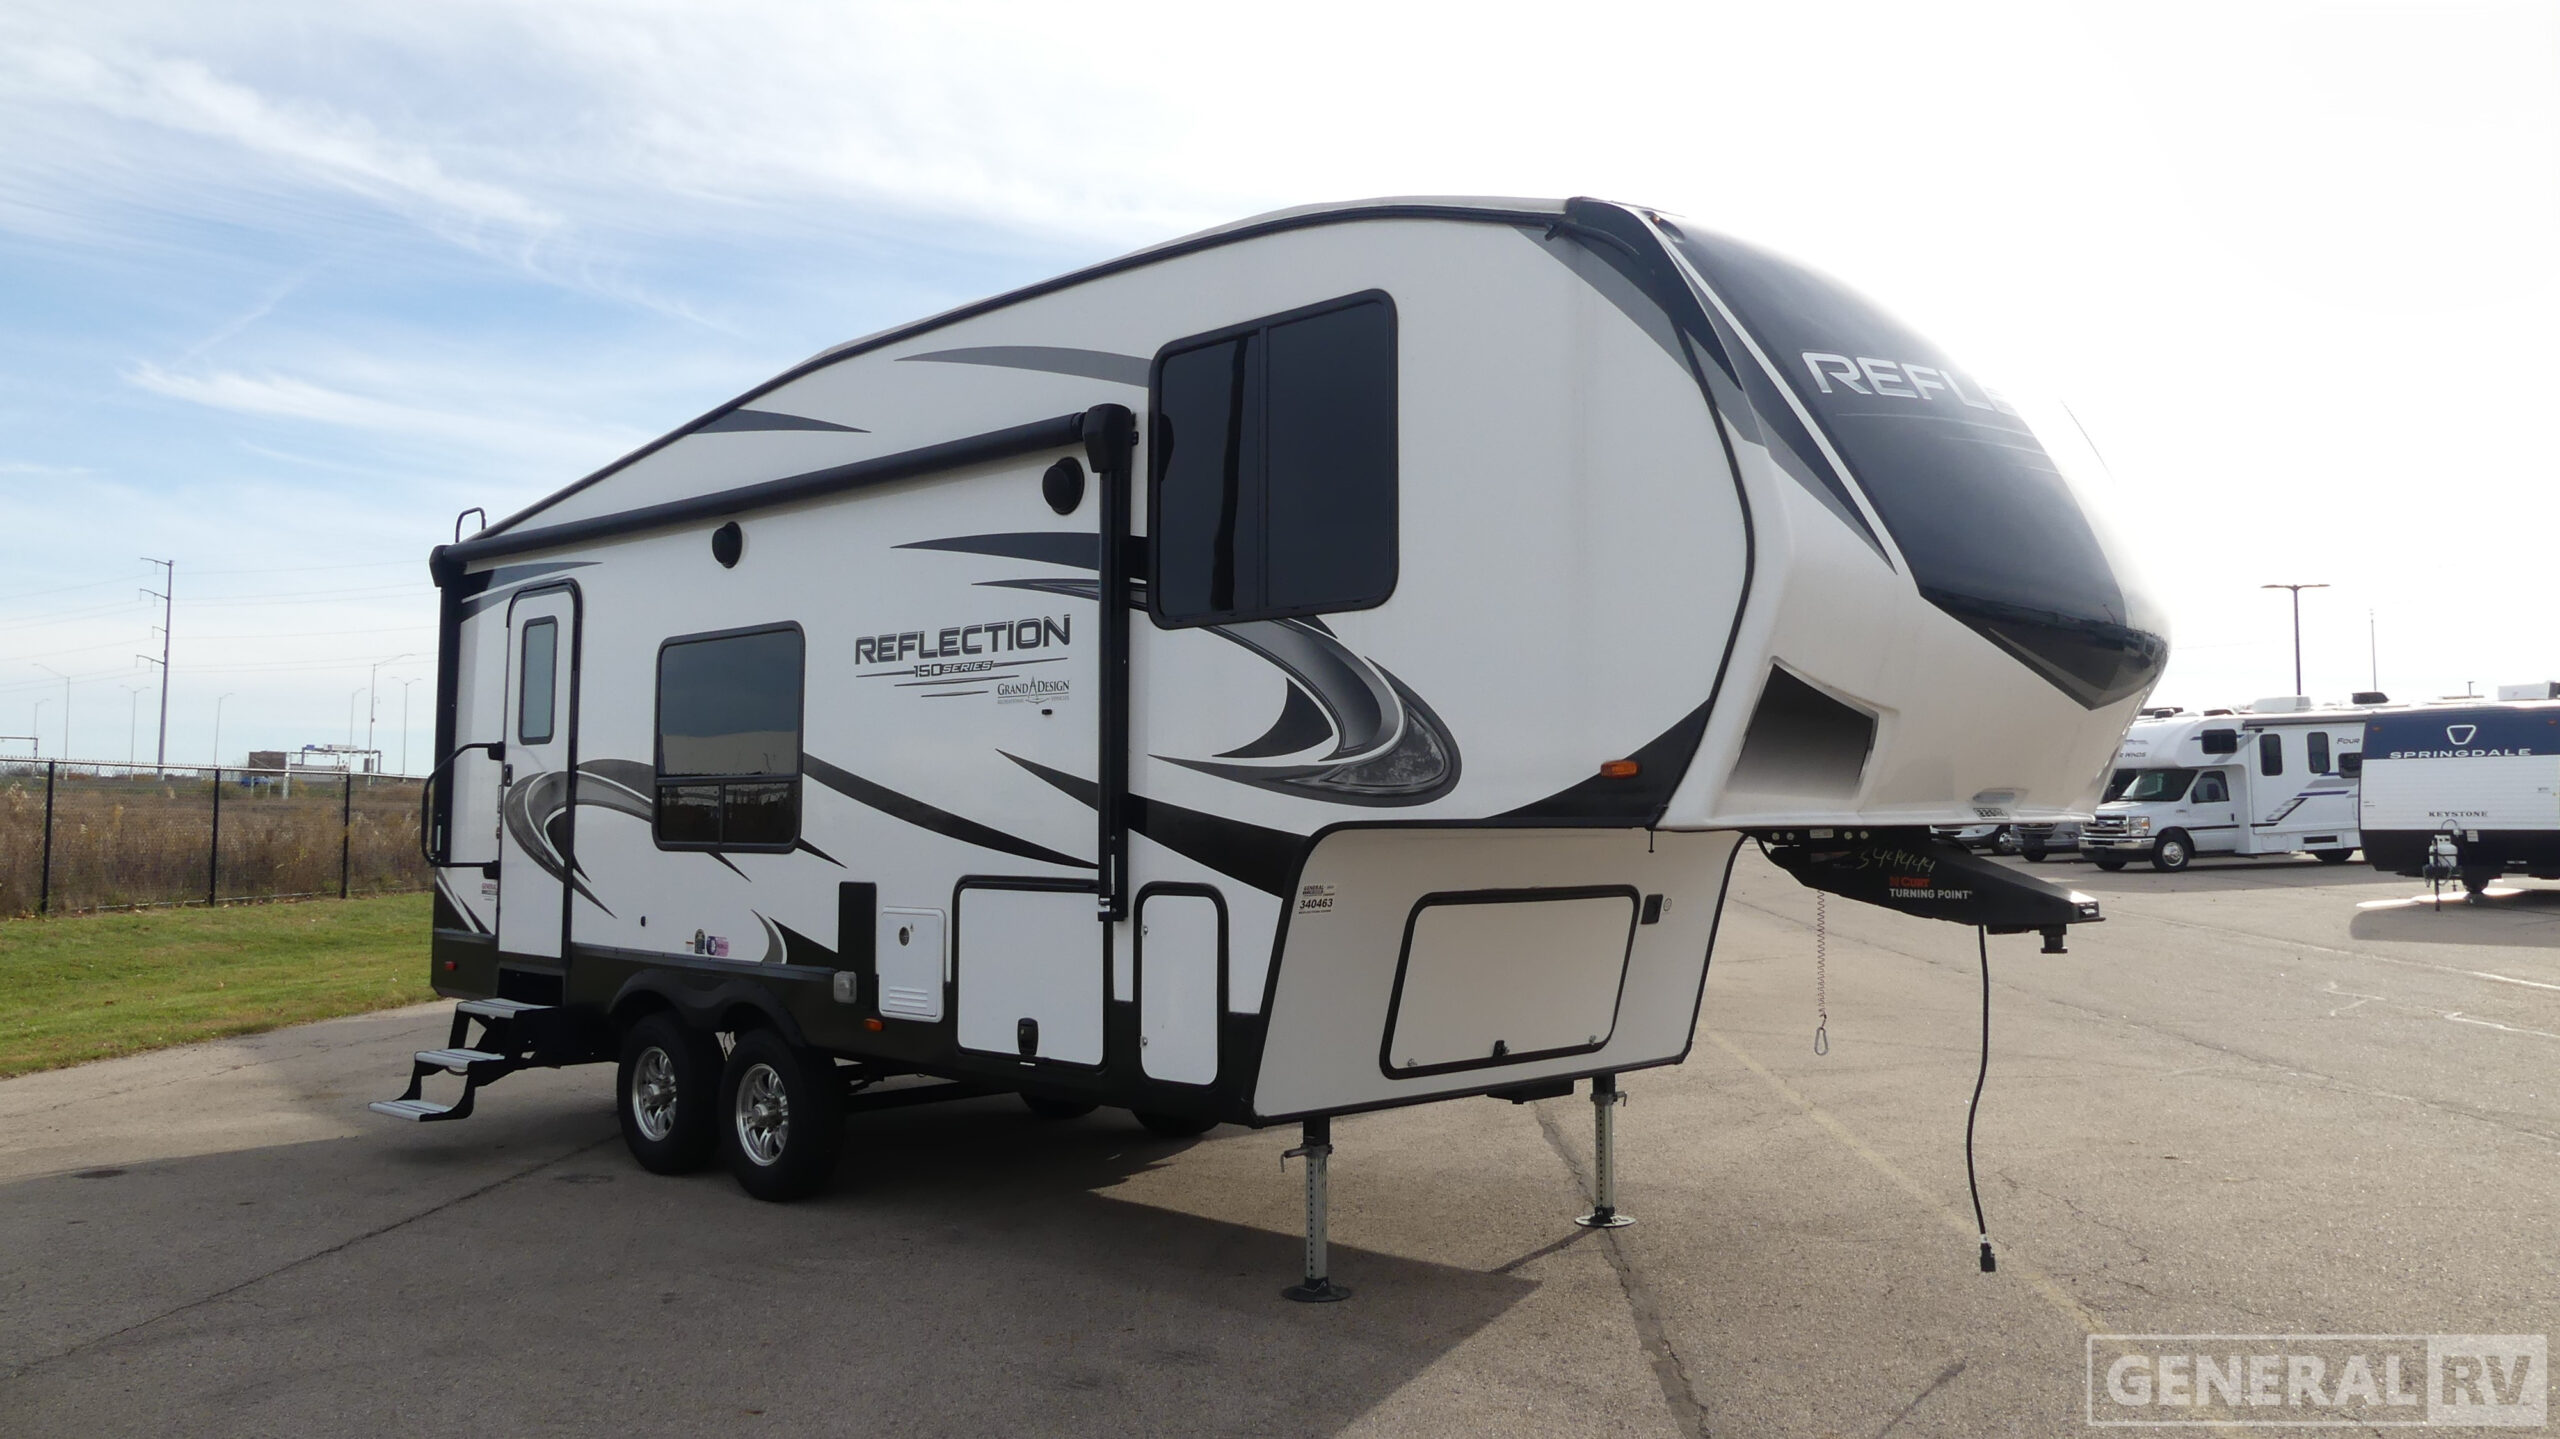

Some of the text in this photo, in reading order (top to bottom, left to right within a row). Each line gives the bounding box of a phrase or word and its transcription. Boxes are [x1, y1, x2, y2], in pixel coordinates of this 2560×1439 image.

[855, 614, 1071, 665] REFLECTION
[914, 660, 993, 678] 150 SERIES
[2389, 748, 2532, 759] SPRINGDALE
[1889, 888, 1970, 900] TURNING POINT
[1299, 898, 1333, 909] 340463
